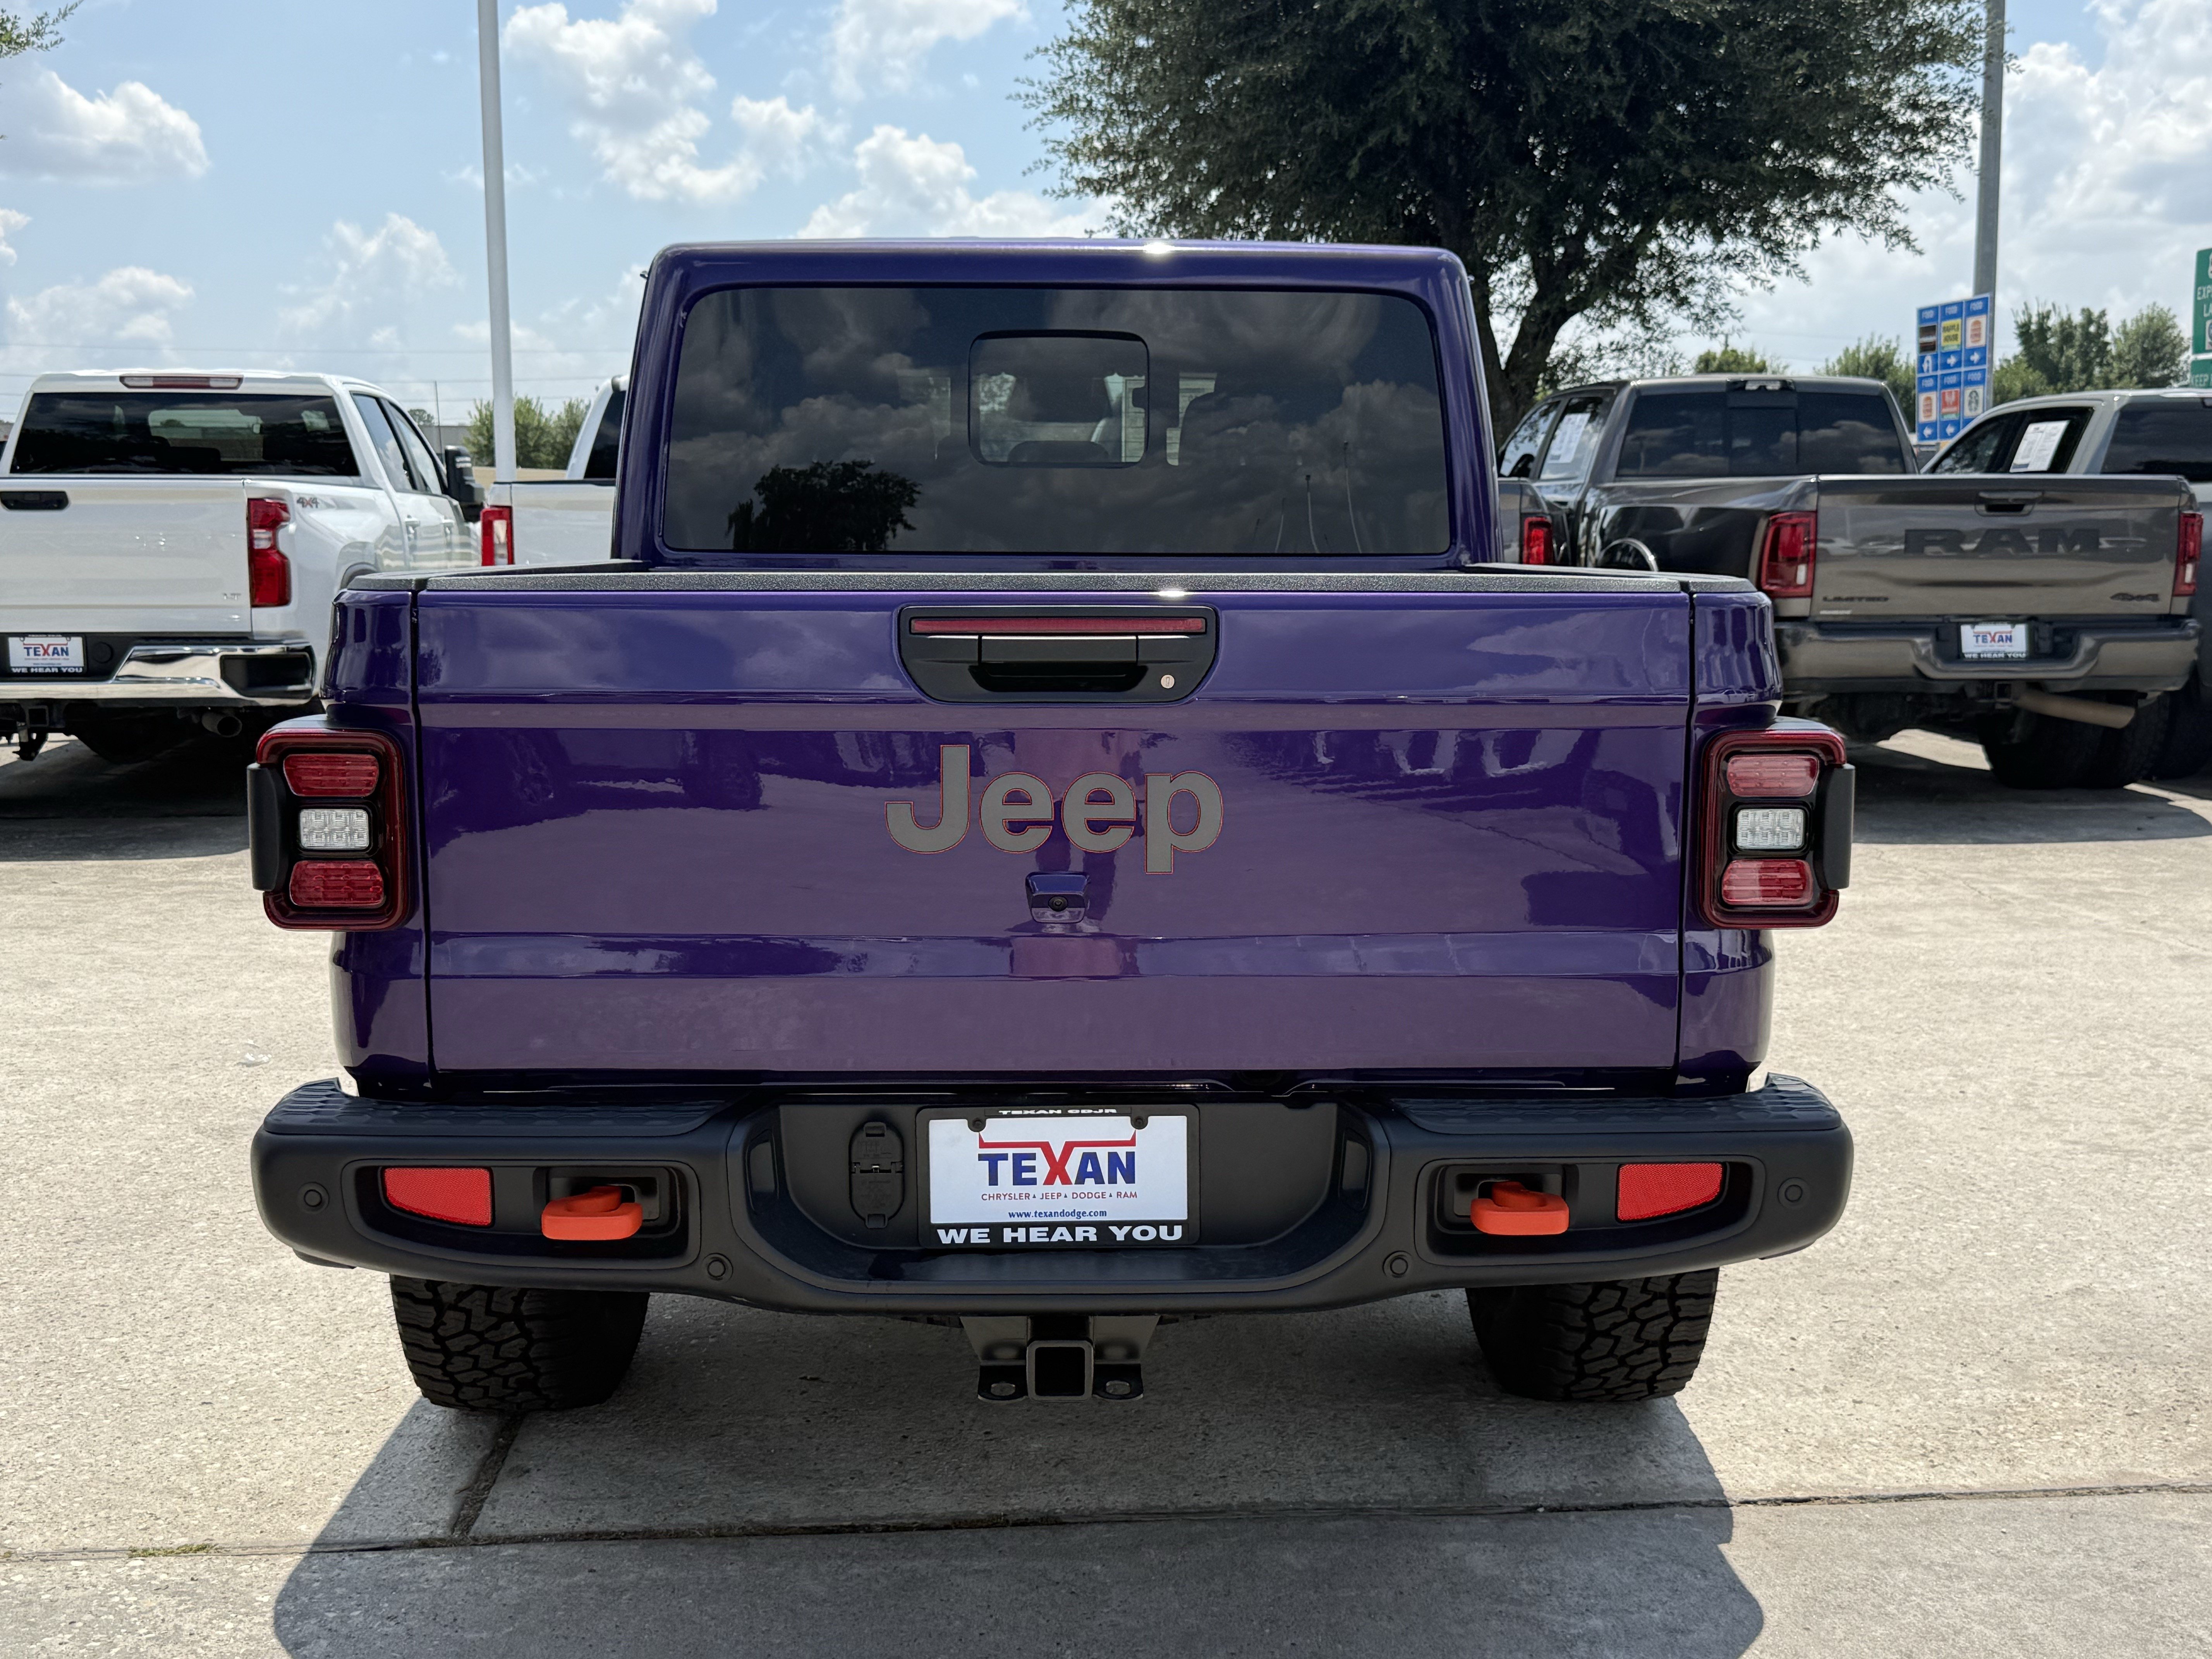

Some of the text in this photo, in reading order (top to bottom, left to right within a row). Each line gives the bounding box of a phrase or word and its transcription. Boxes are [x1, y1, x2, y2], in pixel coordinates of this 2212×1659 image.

[1905, 529, 2100, 553] RAM
[1973, 632, 2013, 644] TEXAN
[23, 644, 69, 656] TEXAN
[884, 744, 1224, 874] Jeep
[978, 1141, 1136, 1186] TEXAN
[1008, 1209, 1107, 1219] www.texandodge.com
[937, 1225, 1182, 1243] WE HEAR YOU
